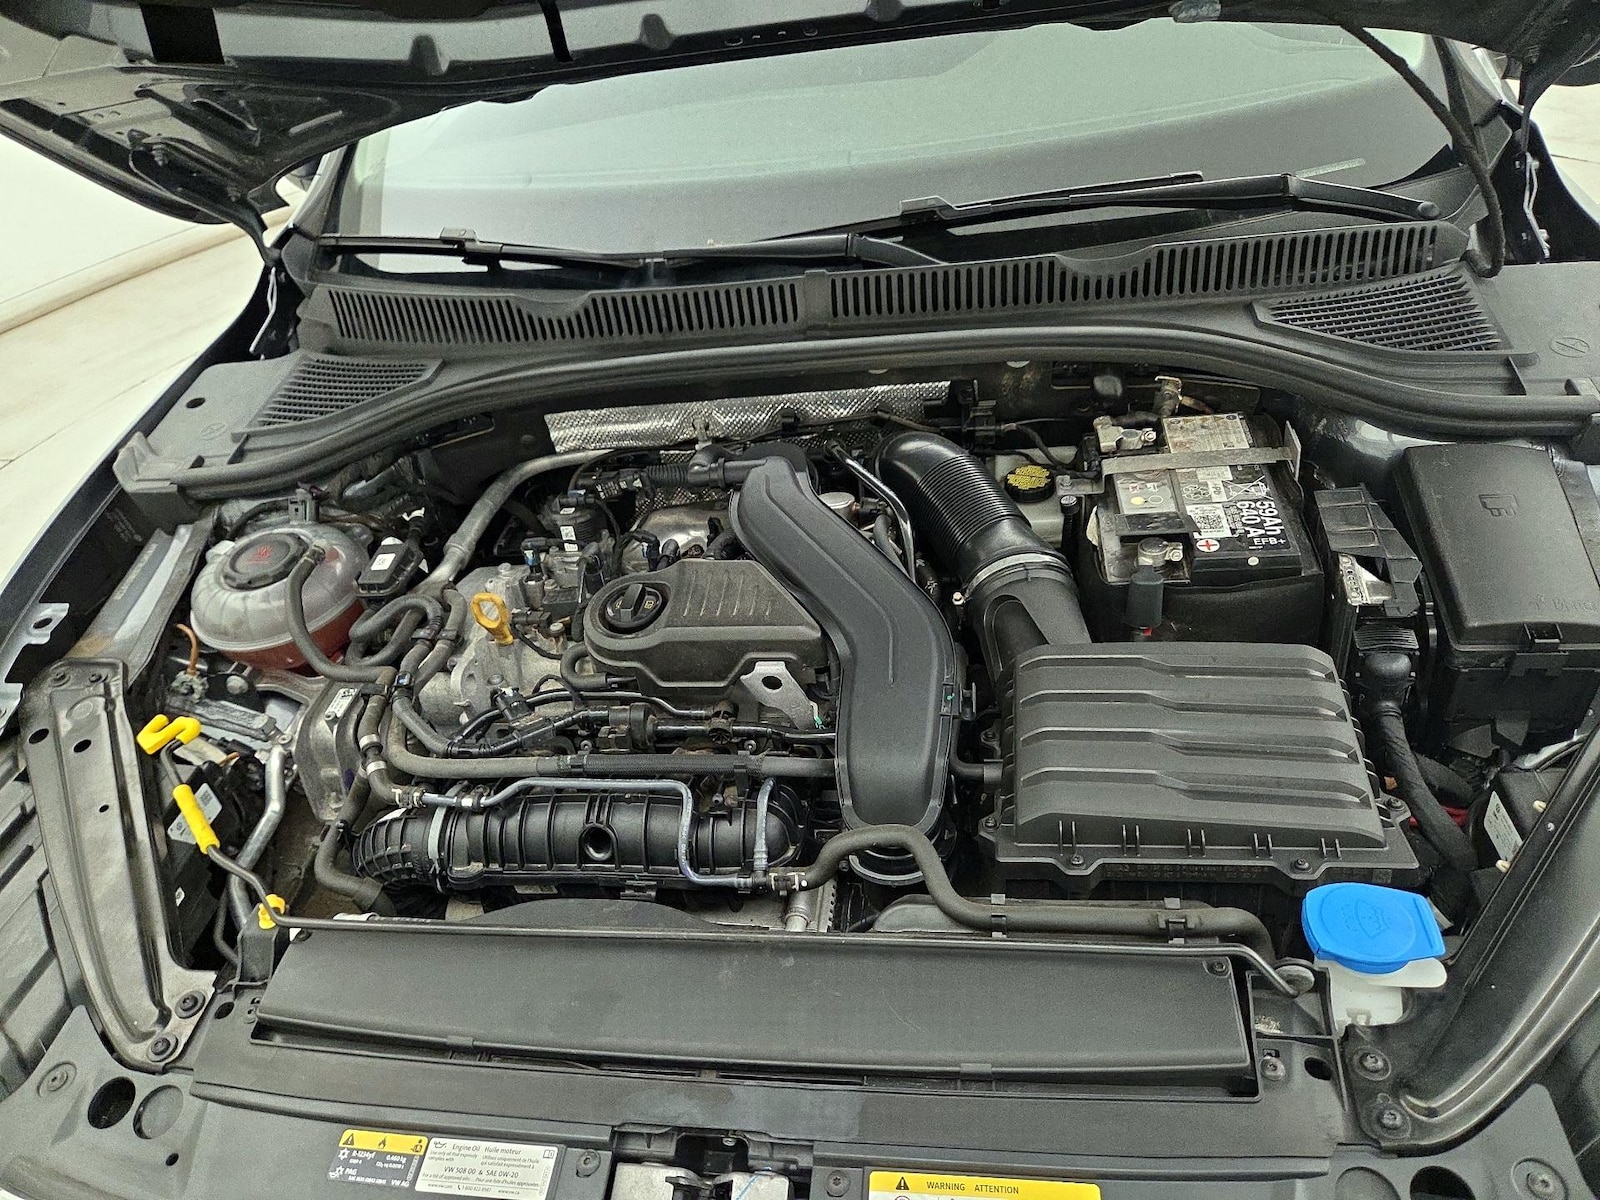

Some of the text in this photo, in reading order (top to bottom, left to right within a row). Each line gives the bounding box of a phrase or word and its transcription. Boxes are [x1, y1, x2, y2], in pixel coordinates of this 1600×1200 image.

[1237, 501, 1266, 538] 640 A
[1255, 501, 1285, 535] 59Ah
[1253, 538, 1287, 546] EFB+
[452, 1144, 471, 1152] Engine
[484, 1146, 499, 1154] Huile
[344, 1167, 358, 1176] PAG
[498, 1170, 519, 1178] 0W-20
[926, 1181, 1019, 1194] WARNING ATTENTION
